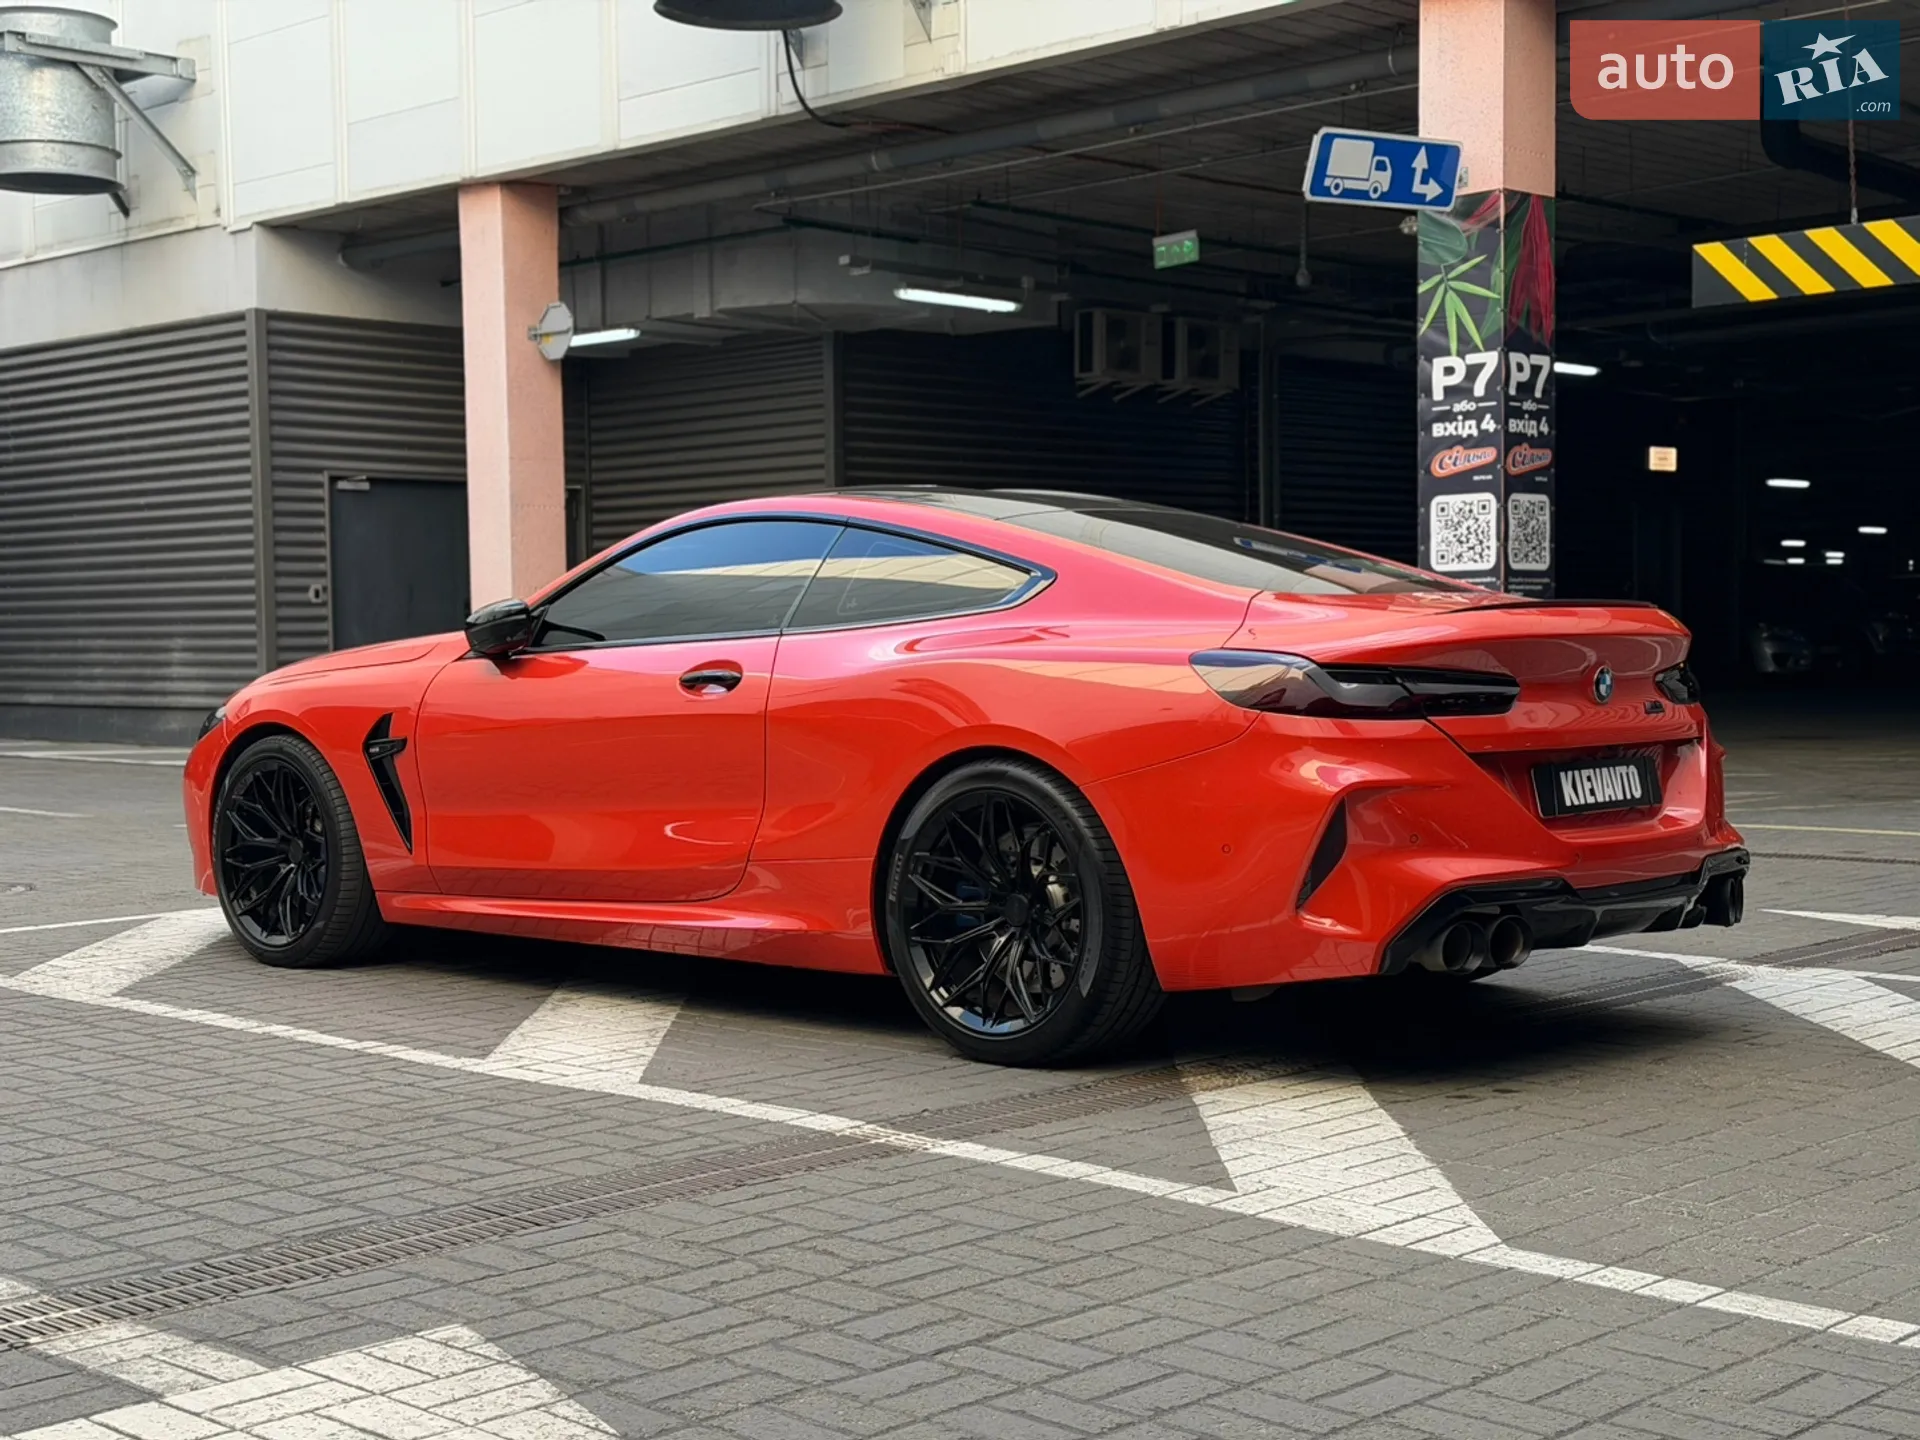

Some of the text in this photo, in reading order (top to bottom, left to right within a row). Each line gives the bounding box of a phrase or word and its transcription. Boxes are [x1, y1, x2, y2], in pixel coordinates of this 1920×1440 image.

[1432, 350, 1499, 401] P7
[1508, 352, 1550, 398] P7
[1452, 399, 1477, 412] або
[1522, 399, 1538, 411] або
[1432, 413, 1497, 438] вхід 4
[1508, 414, 1549, 438] вхід 4
